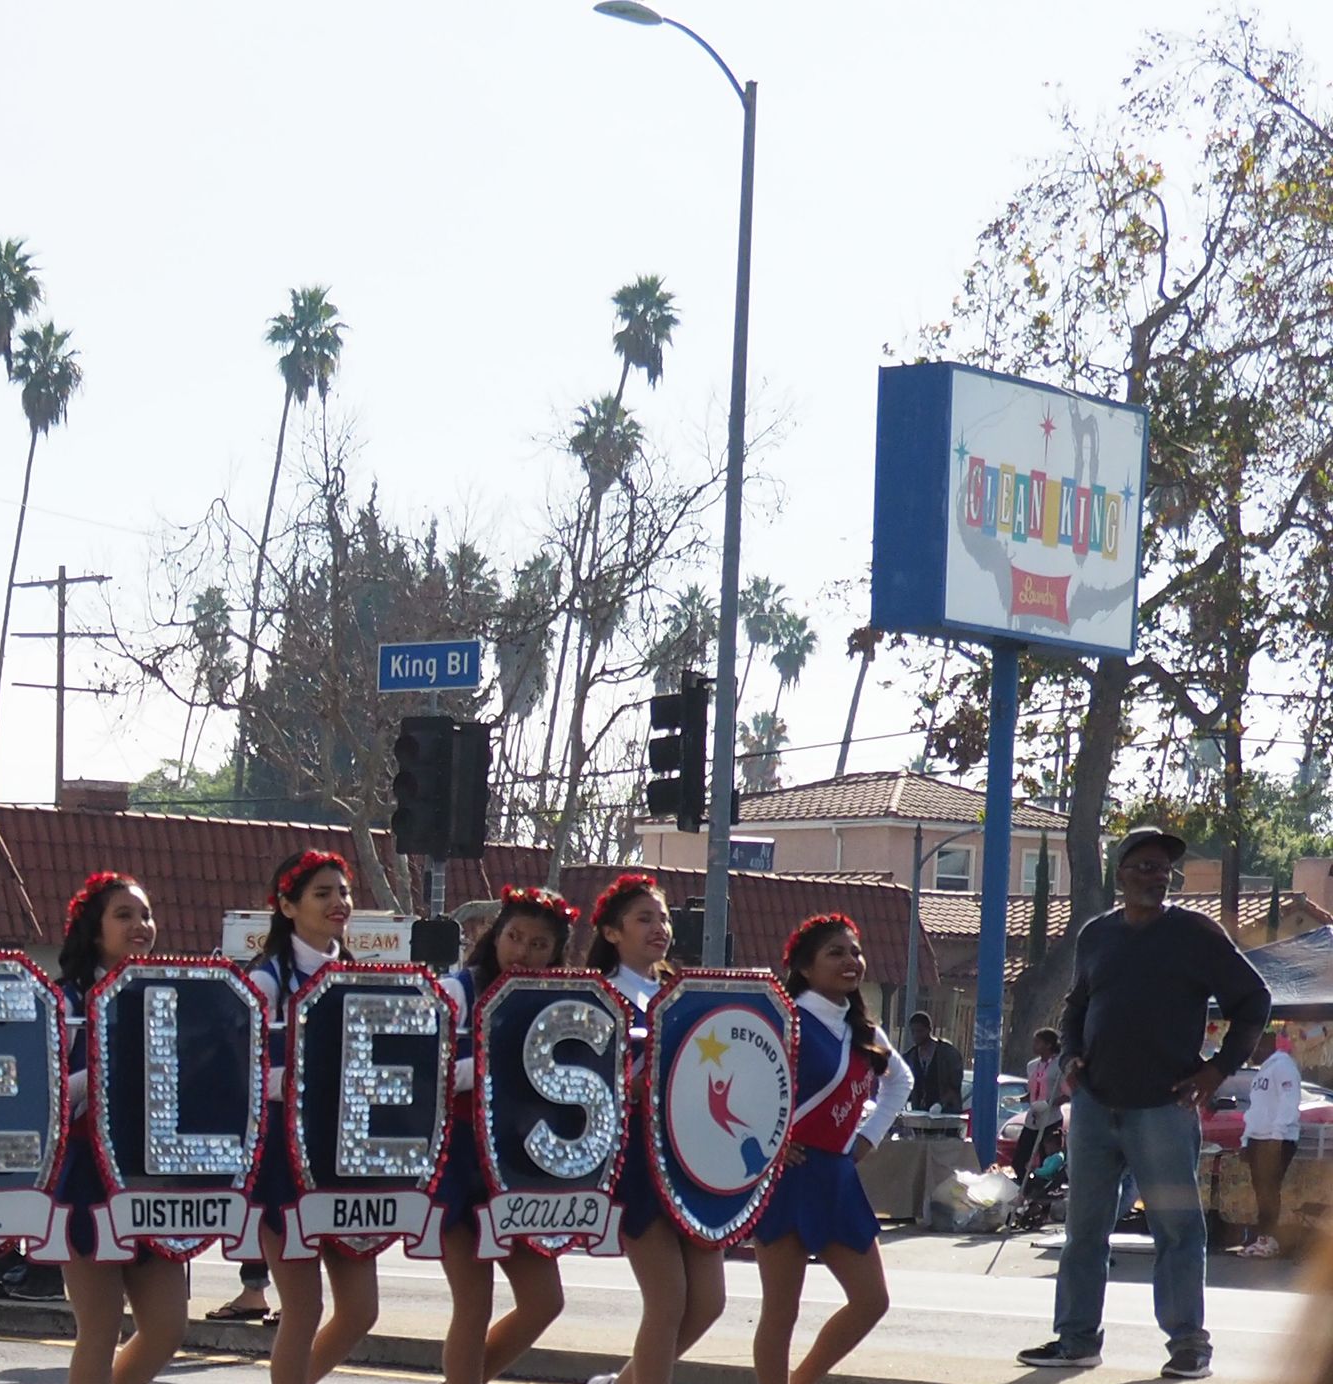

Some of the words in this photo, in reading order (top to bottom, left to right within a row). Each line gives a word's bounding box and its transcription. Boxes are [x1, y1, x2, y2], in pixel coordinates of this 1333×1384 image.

[968, 464, 1044, 537] CLEAN
[1059, 486, 1120, 554] KING
[390, 653, 437, 684] King
[730, 1026, 777, 1063] BEYOND
[144, 986, 246, 1175] L
[335, 993, 438, 1177] E
[523, 999, 616, 1179] S
[774, 1063, 789, 1101] THE
[768, 1106, 788, 1147] BELL
[132, 1198, 232, 1228] DISTRICT
[333, 1198, 397, 1228] BAND
